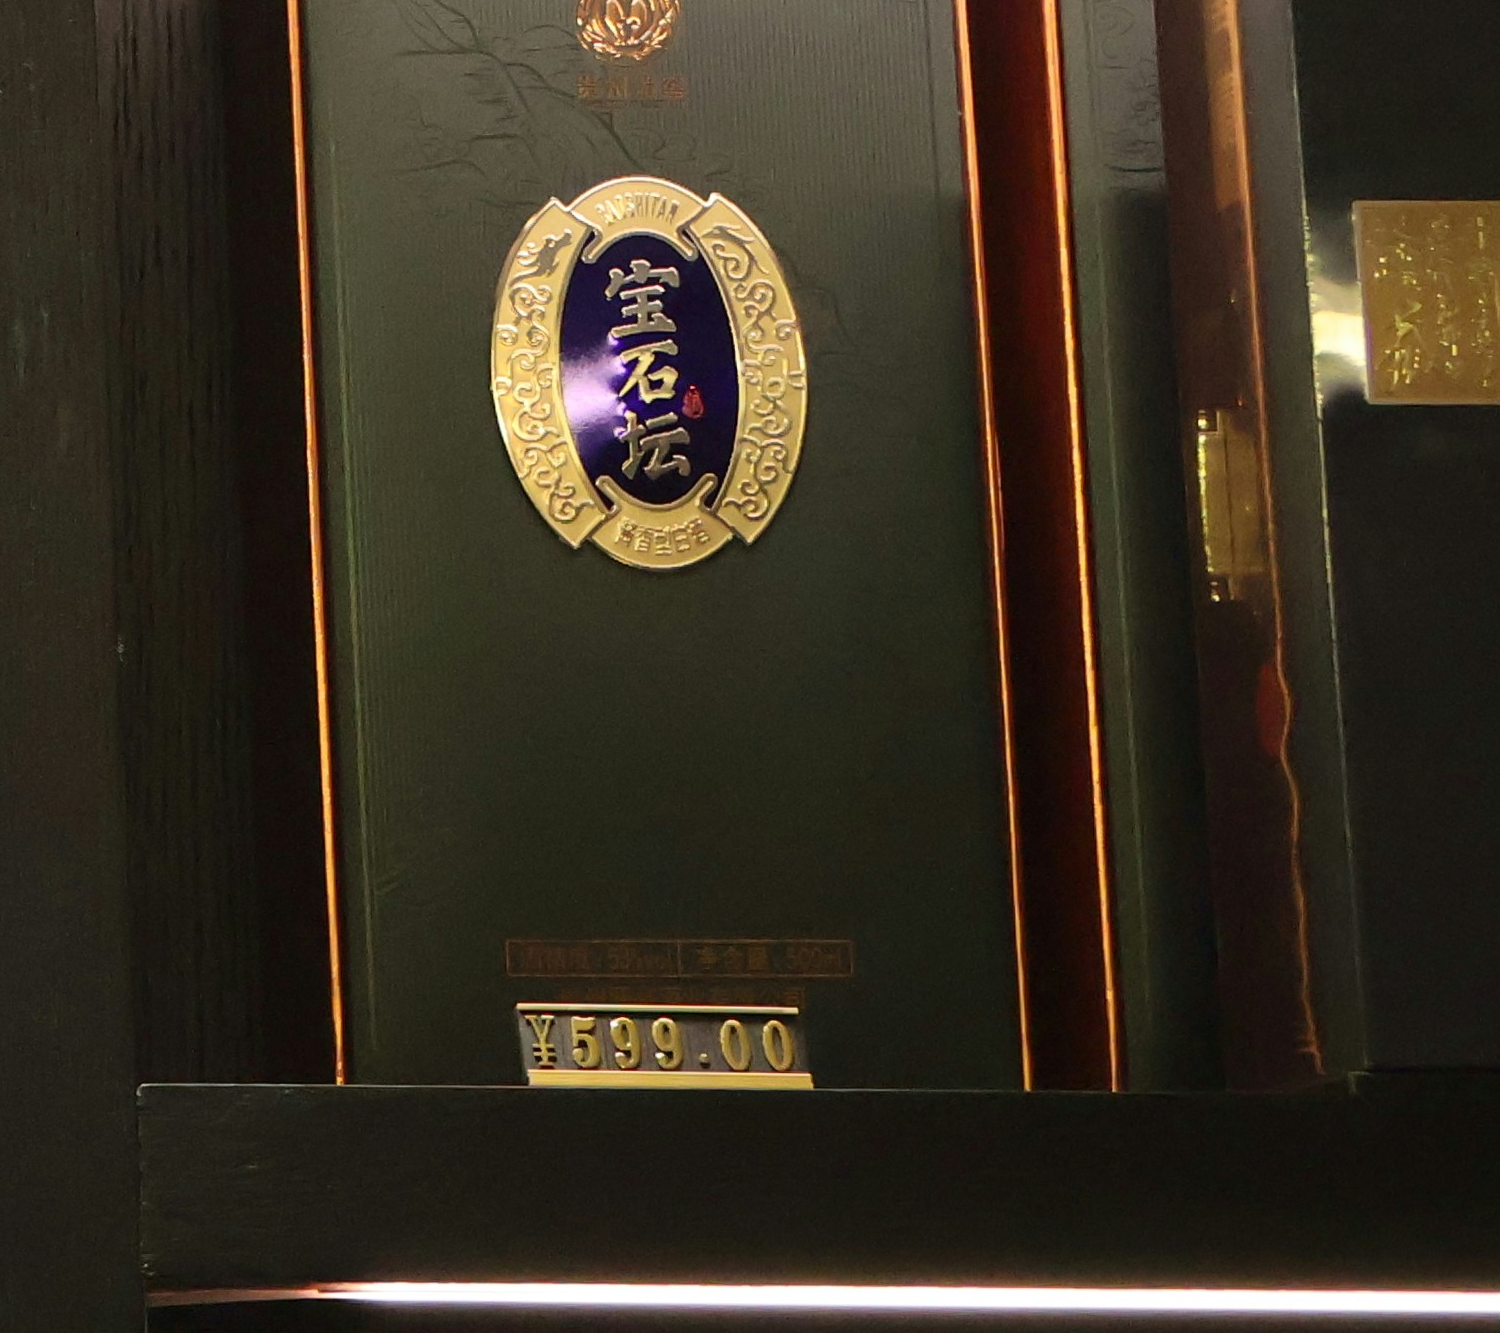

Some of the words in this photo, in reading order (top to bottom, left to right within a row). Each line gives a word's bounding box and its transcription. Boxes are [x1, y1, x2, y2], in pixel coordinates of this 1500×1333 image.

[605, 259, 691, 480] 宝石坛
[525, 1015, 794, 1071] ¥599.00
